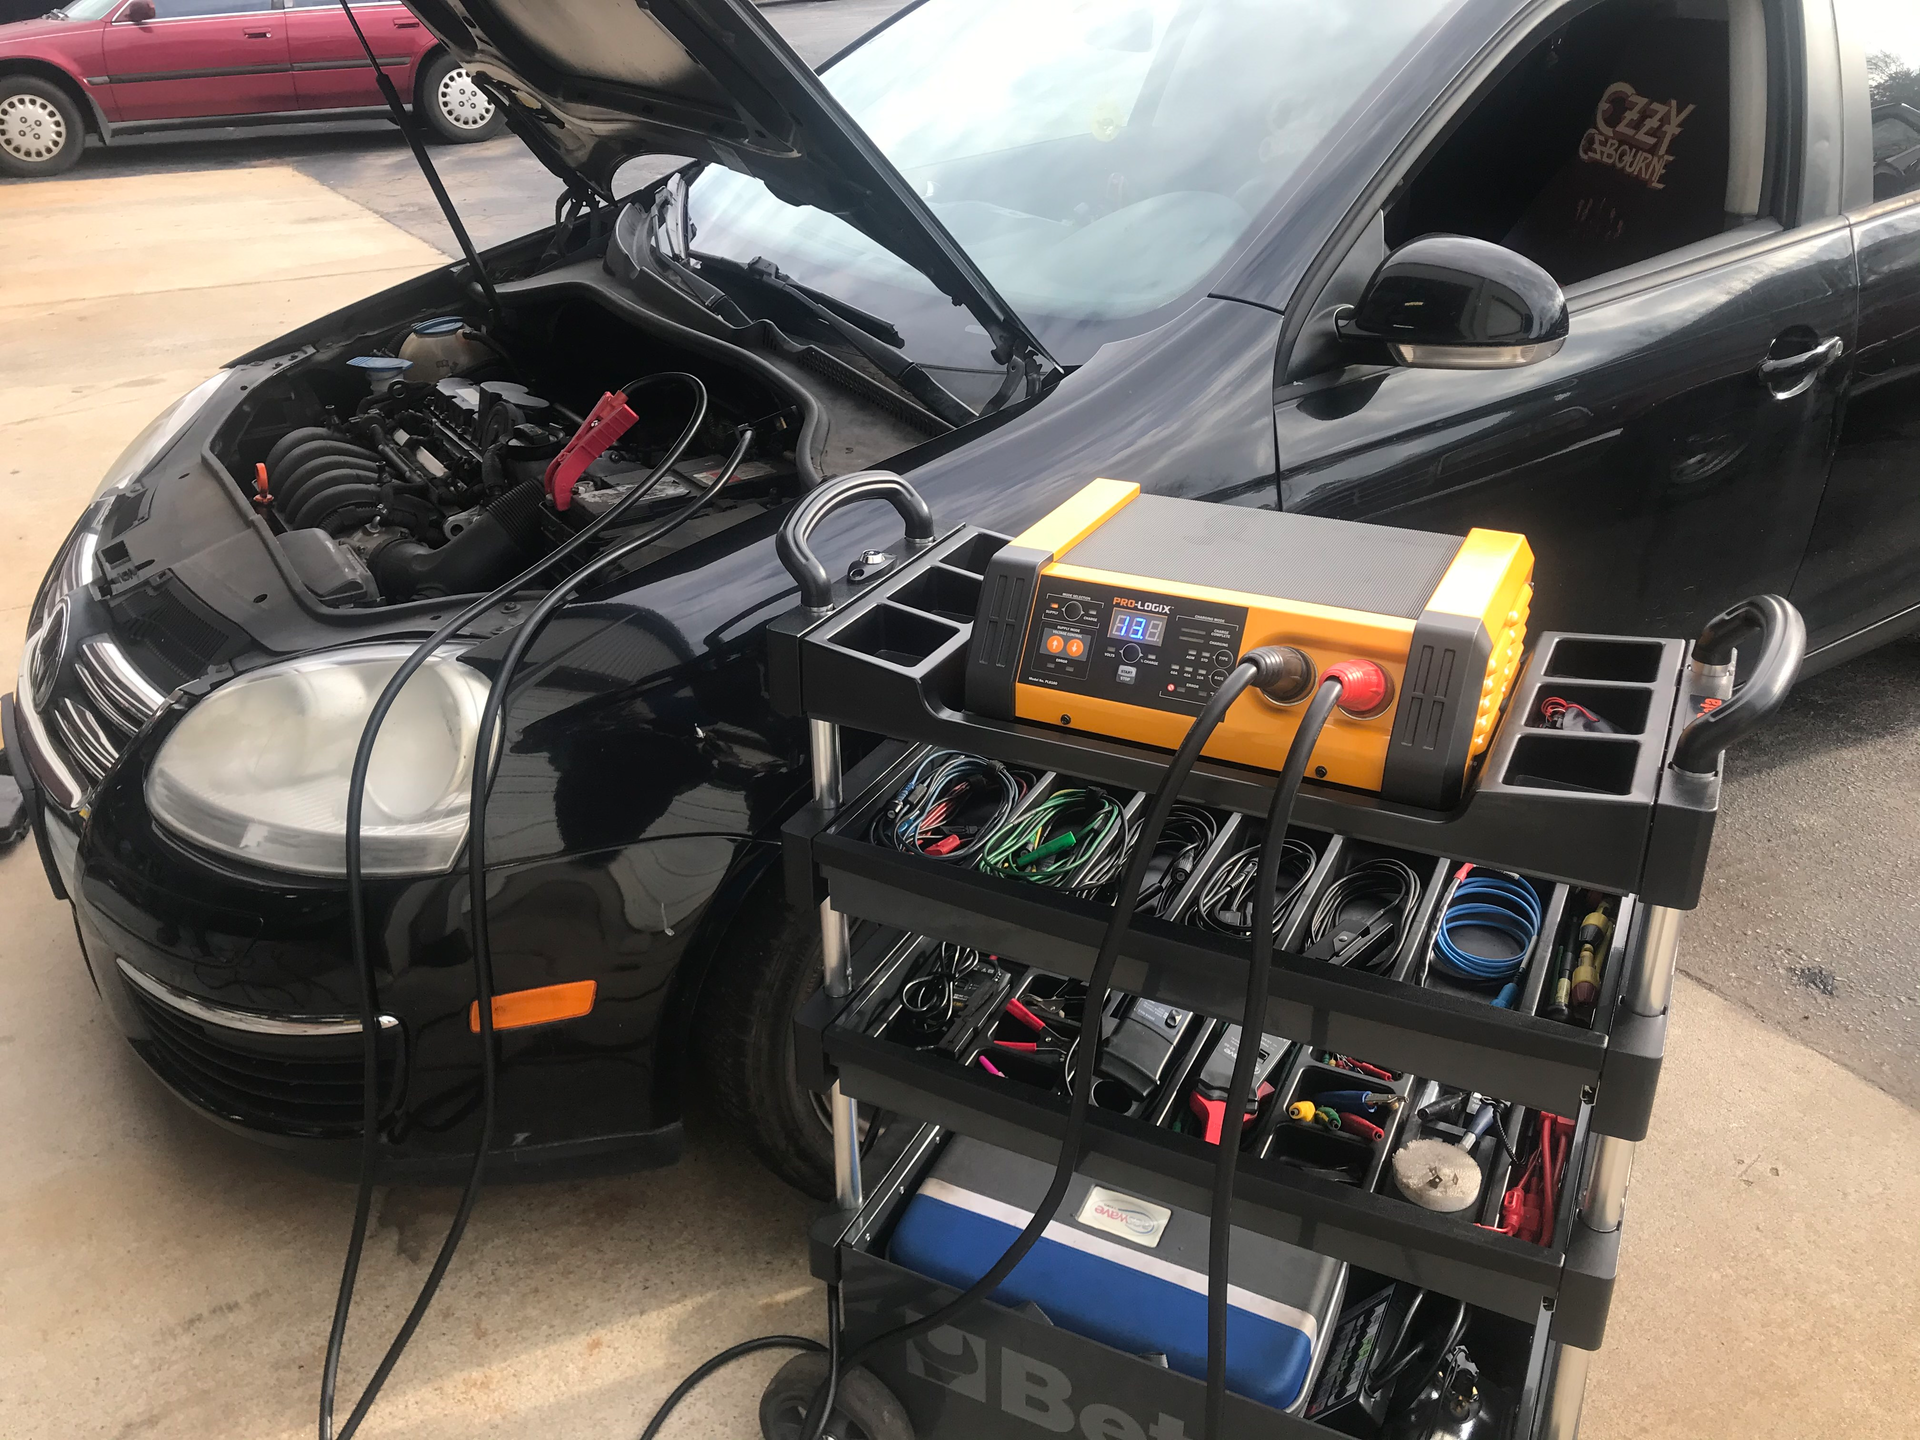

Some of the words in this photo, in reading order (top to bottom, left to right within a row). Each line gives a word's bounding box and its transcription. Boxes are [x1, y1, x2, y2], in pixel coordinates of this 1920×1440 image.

[1596, 81, 1698, 156] OZZY
[1579, 128, 1676, 189] OSBOURNE
[1113, 597, 1171, 614] PRO-LOGIX
